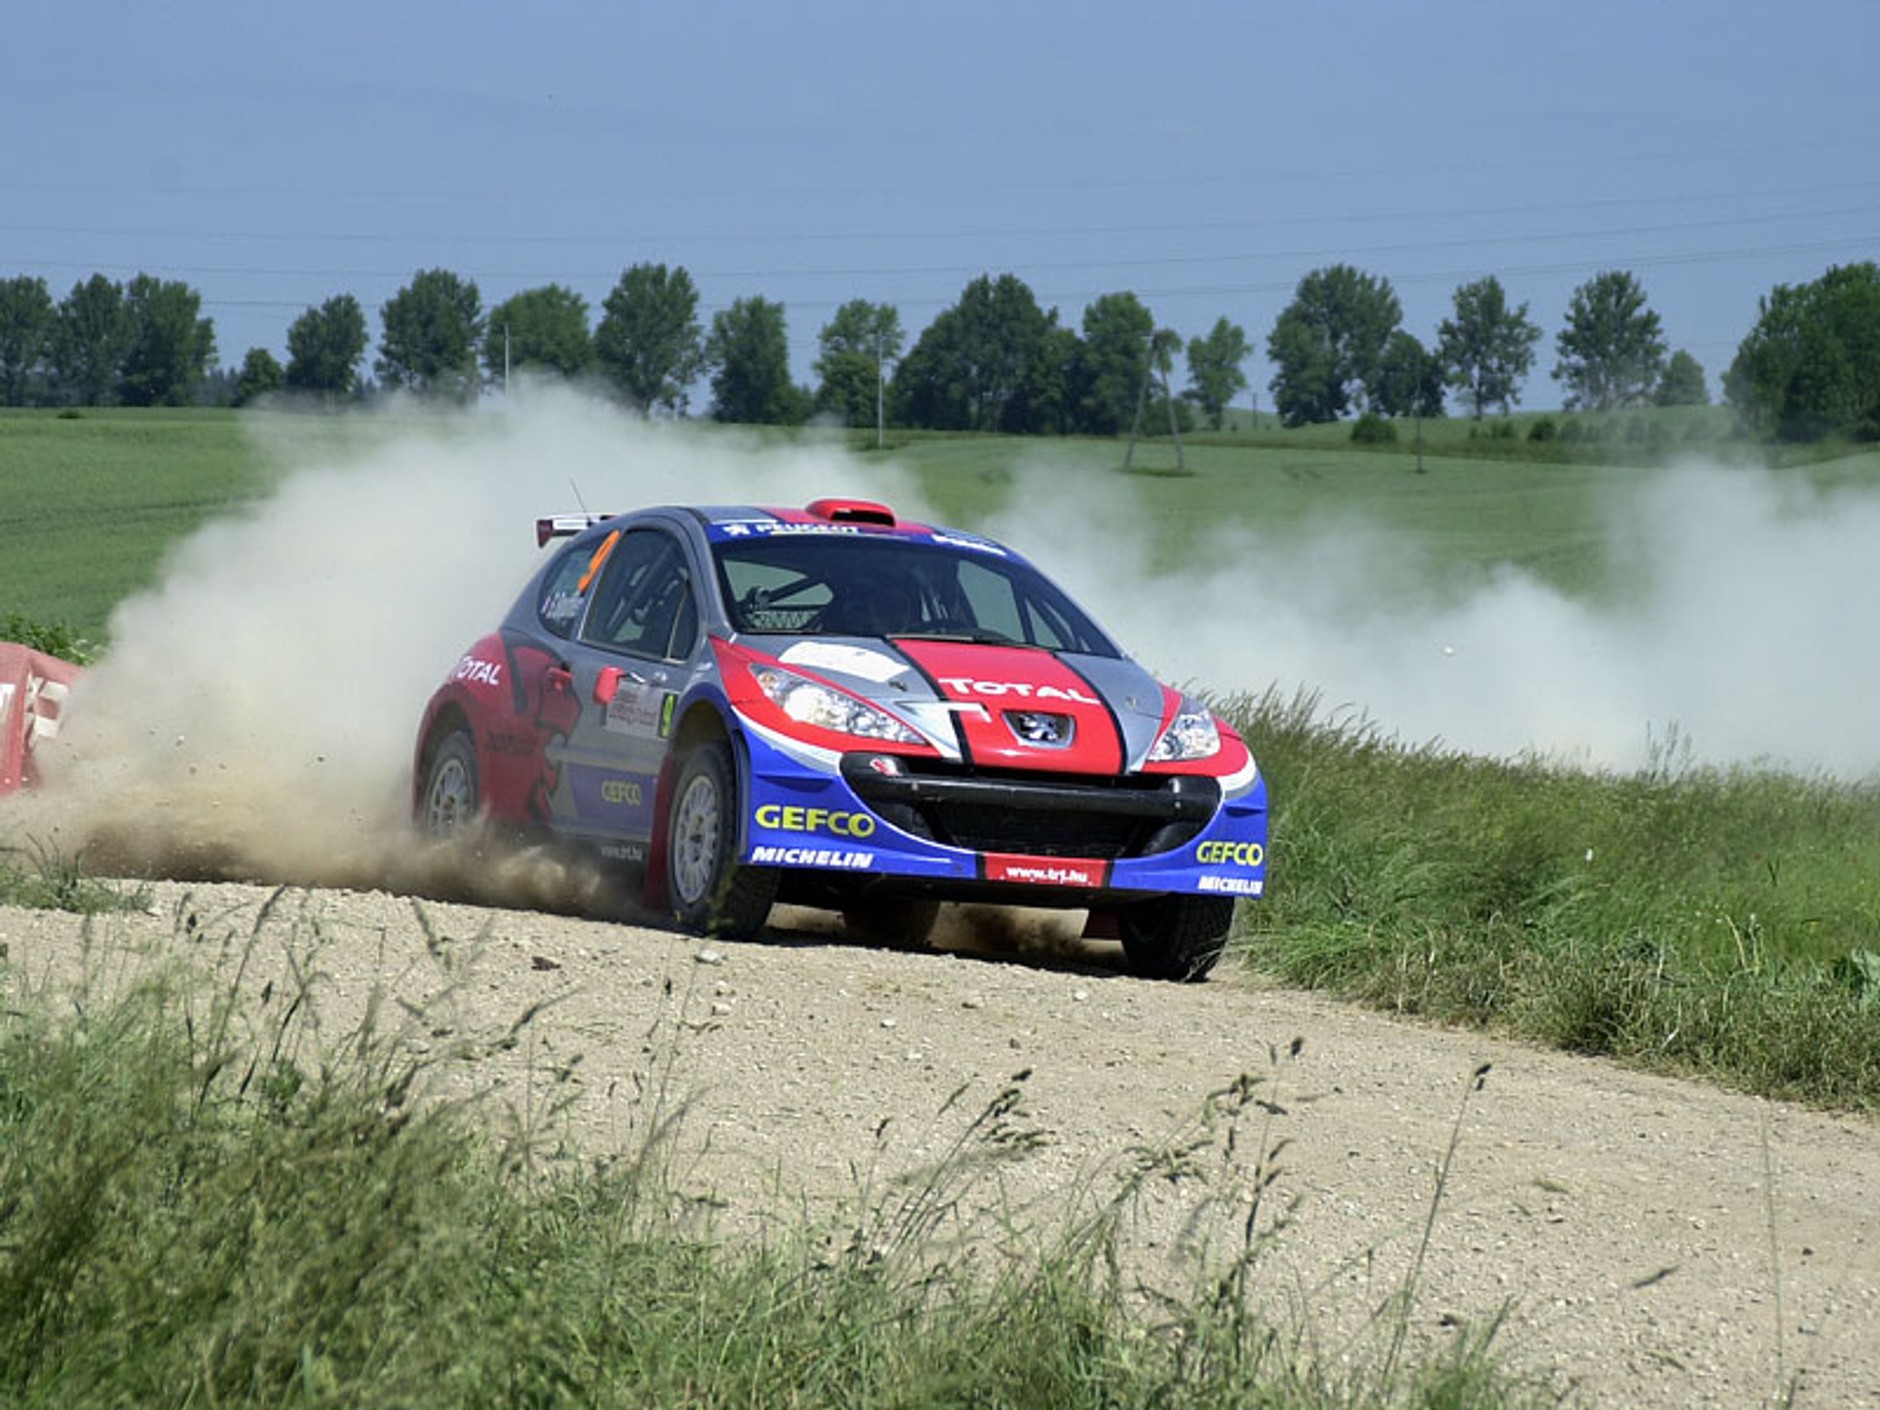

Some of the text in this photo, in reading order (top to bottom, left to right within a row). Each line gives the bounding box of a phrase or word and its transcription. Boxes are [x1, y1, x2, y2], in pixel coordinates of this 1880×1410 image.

[938, 678, 1101, 705] TOTAL
[755, 805, 876, 838] GEFCO
[752, 846, 873, 868] MICHELIN
[1196, 841, 1263, 866] GEFCO
[1198, 875, 1264, 895] MICHELIN
